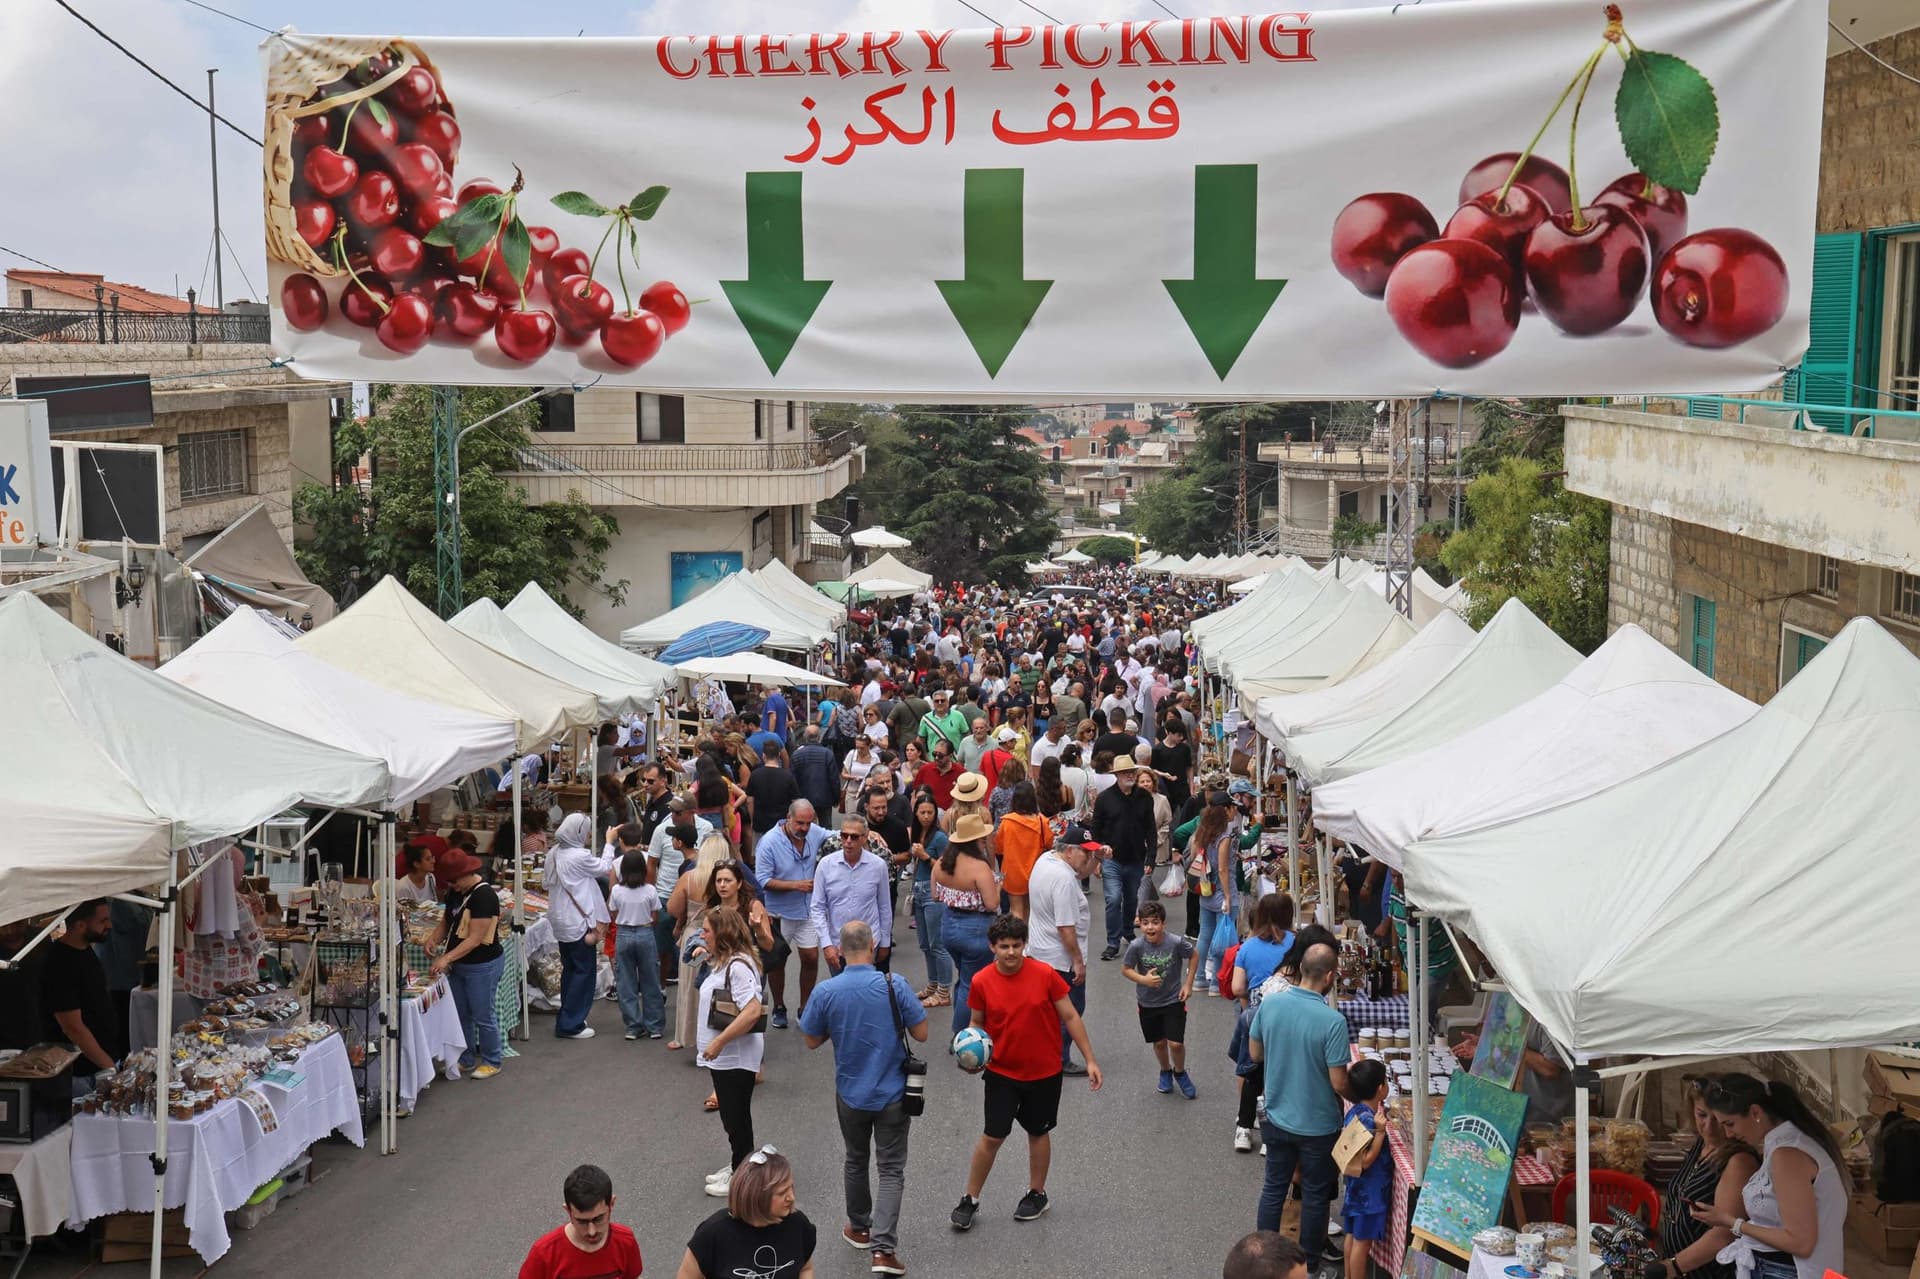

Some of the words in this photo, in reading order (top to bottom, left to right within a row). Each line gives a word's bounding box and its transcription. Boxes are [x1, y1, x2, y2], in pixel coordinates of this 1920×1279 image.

[656, 31, 953, 79] CHERRY
[985, 13, 1317, 71] PICKING
[784, 82, 955, 165] الكرز
[992, 77, 1180, 145] قطف
